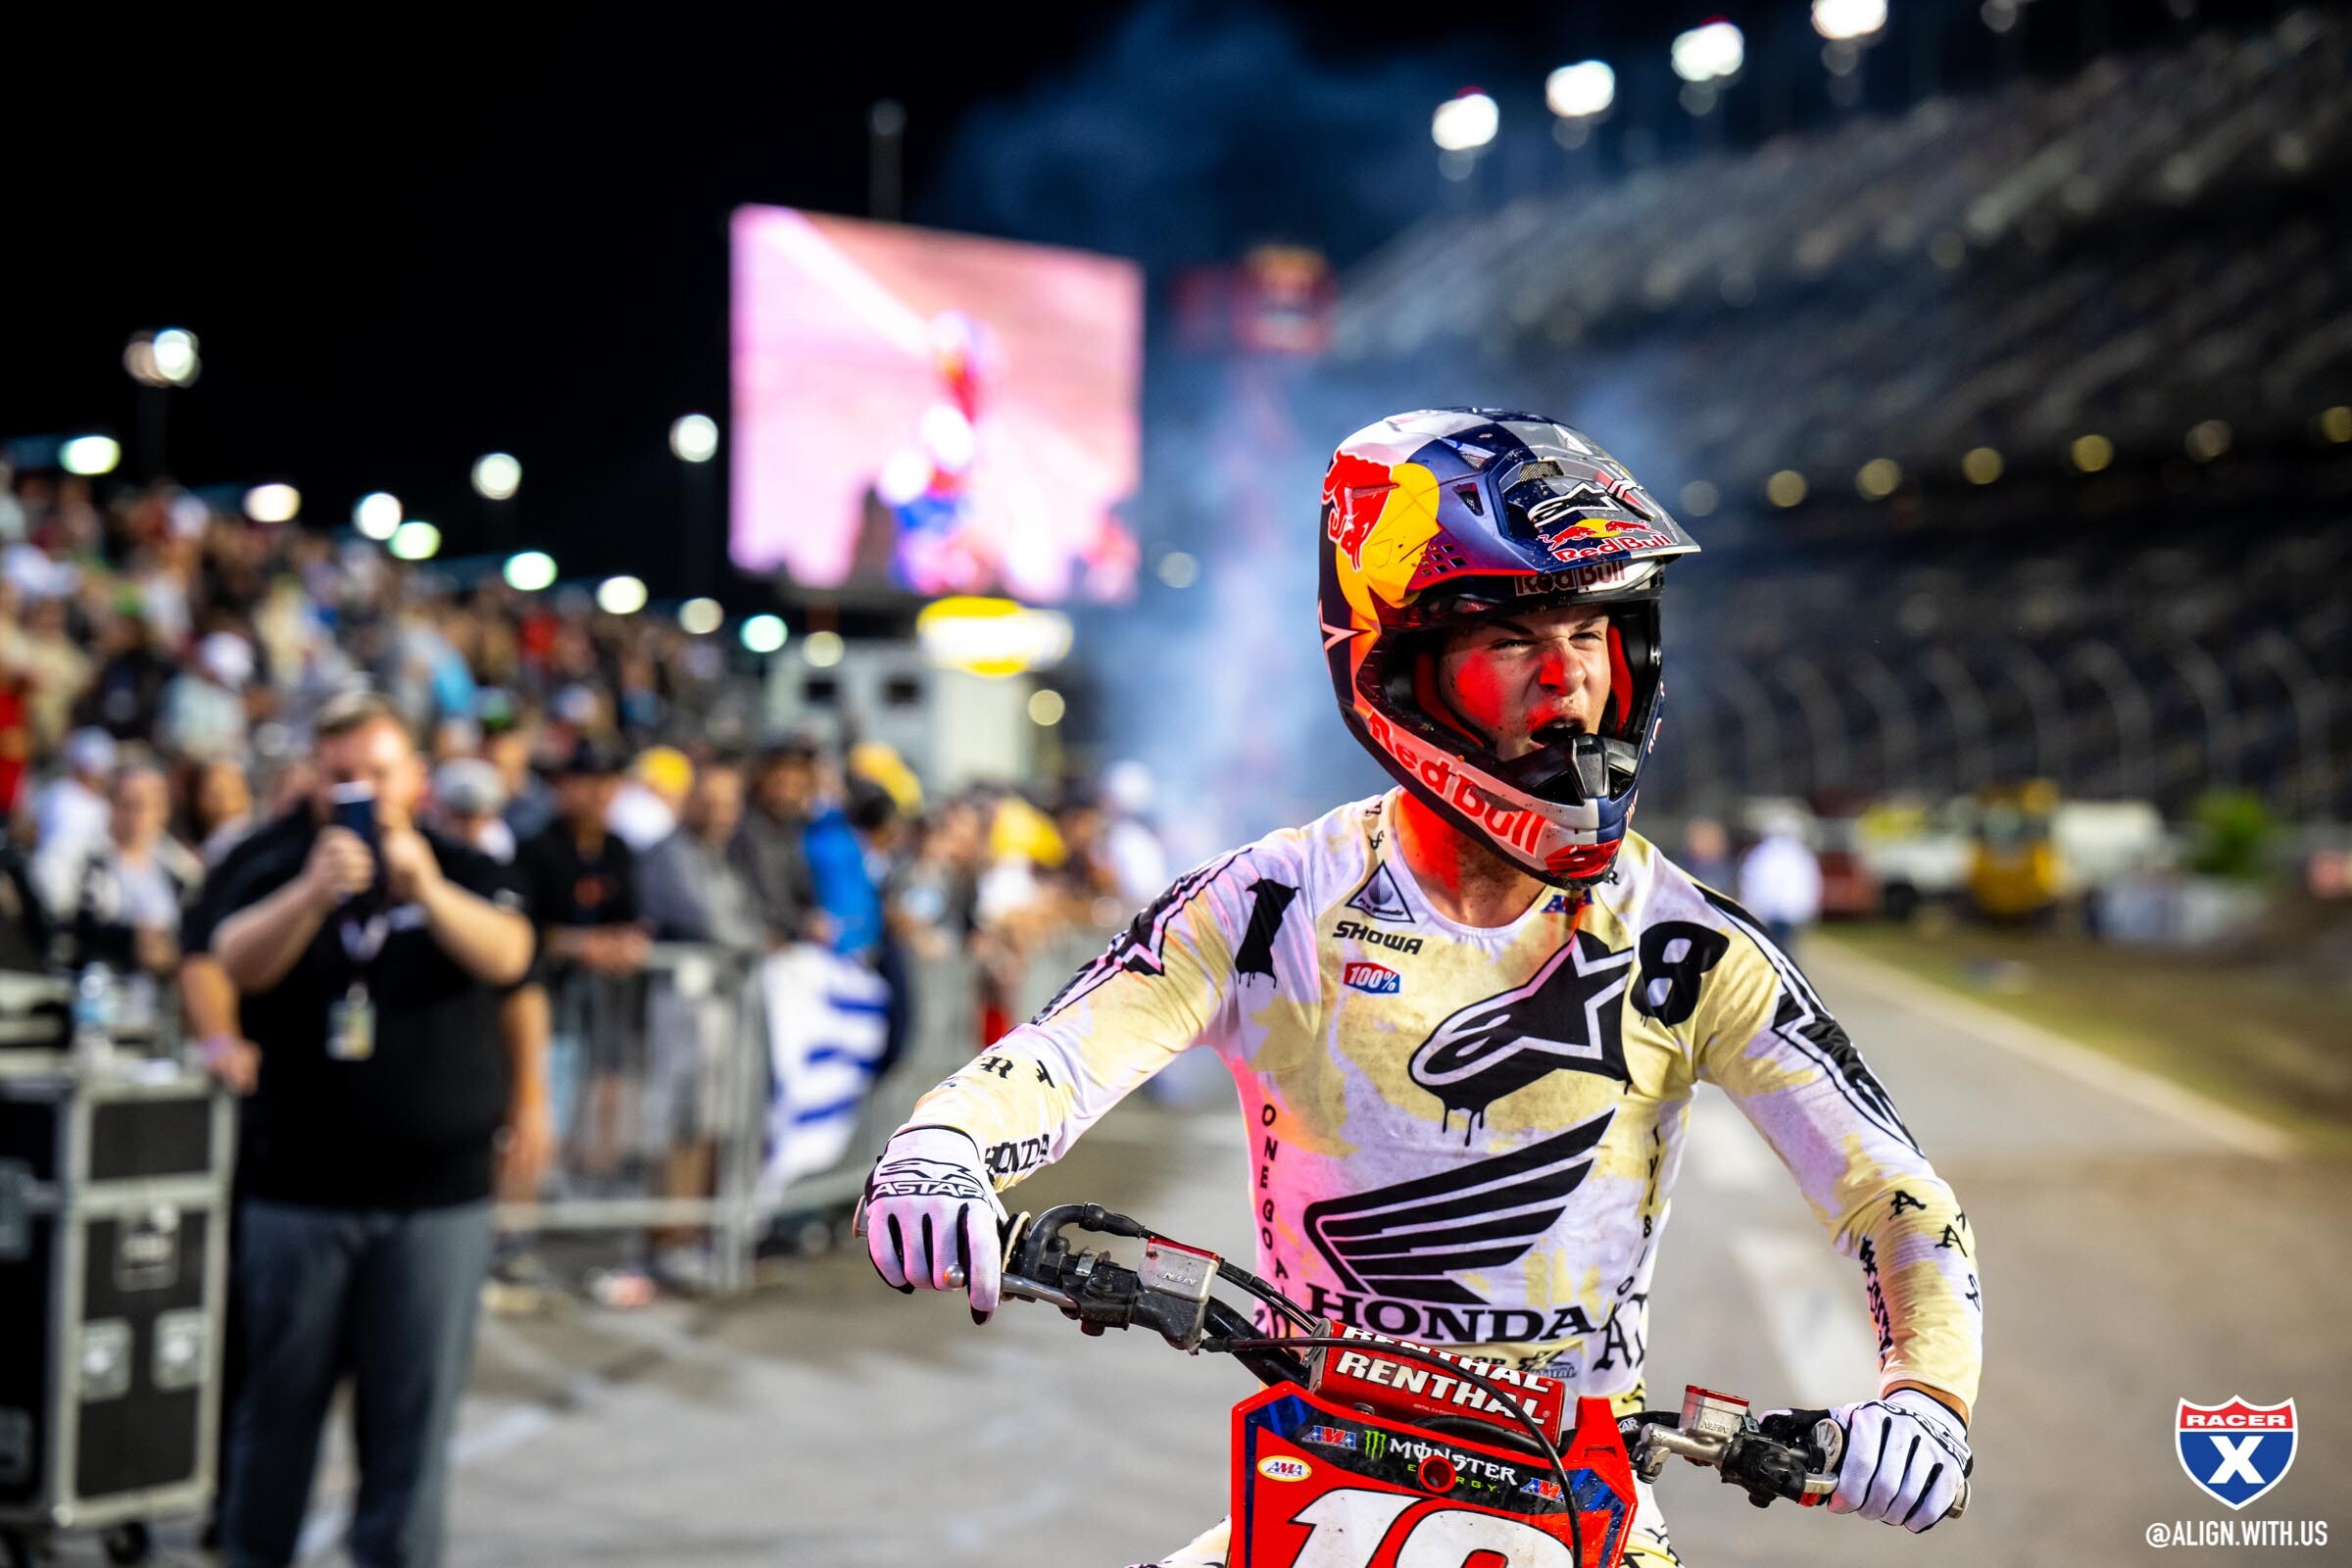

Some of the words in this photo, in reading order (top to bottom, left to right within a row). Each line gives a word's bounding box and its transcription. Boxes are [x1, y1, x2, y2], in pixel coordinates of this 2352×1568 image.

[1553, 537, 1623, 563] Red
[1619, 534, 1674, 551] Bull
[1515, 568, 1576, 595] Red
[1579, 560, 1627, 587] Bull
[1368, 712, 1453, 796] Red
[1452, 772, 1547, 856] Bull
[1235, 878, 1300, 987] 1
[1333, 920, 1424, 956] SHOWA
[1348, 965, 1397, 992] 100%
[1629, 920, 1730, 1027] 8
[873, 1180, 988, 1201] ASTAR
[1306, 1282, 1596, 1343] HONDA
[1341, 1325, 1550, 1394] RENTHAL
[1335, 1349, 1546, 1426] RENTHAL
[1301, 1425, 1357, 1450] AMA
[1265, 1461, 1303, 1476] AMA
[1390, 1438, 1519, 1487] MONSTER
[1406, 1463, 1497, 1493] ERGY
